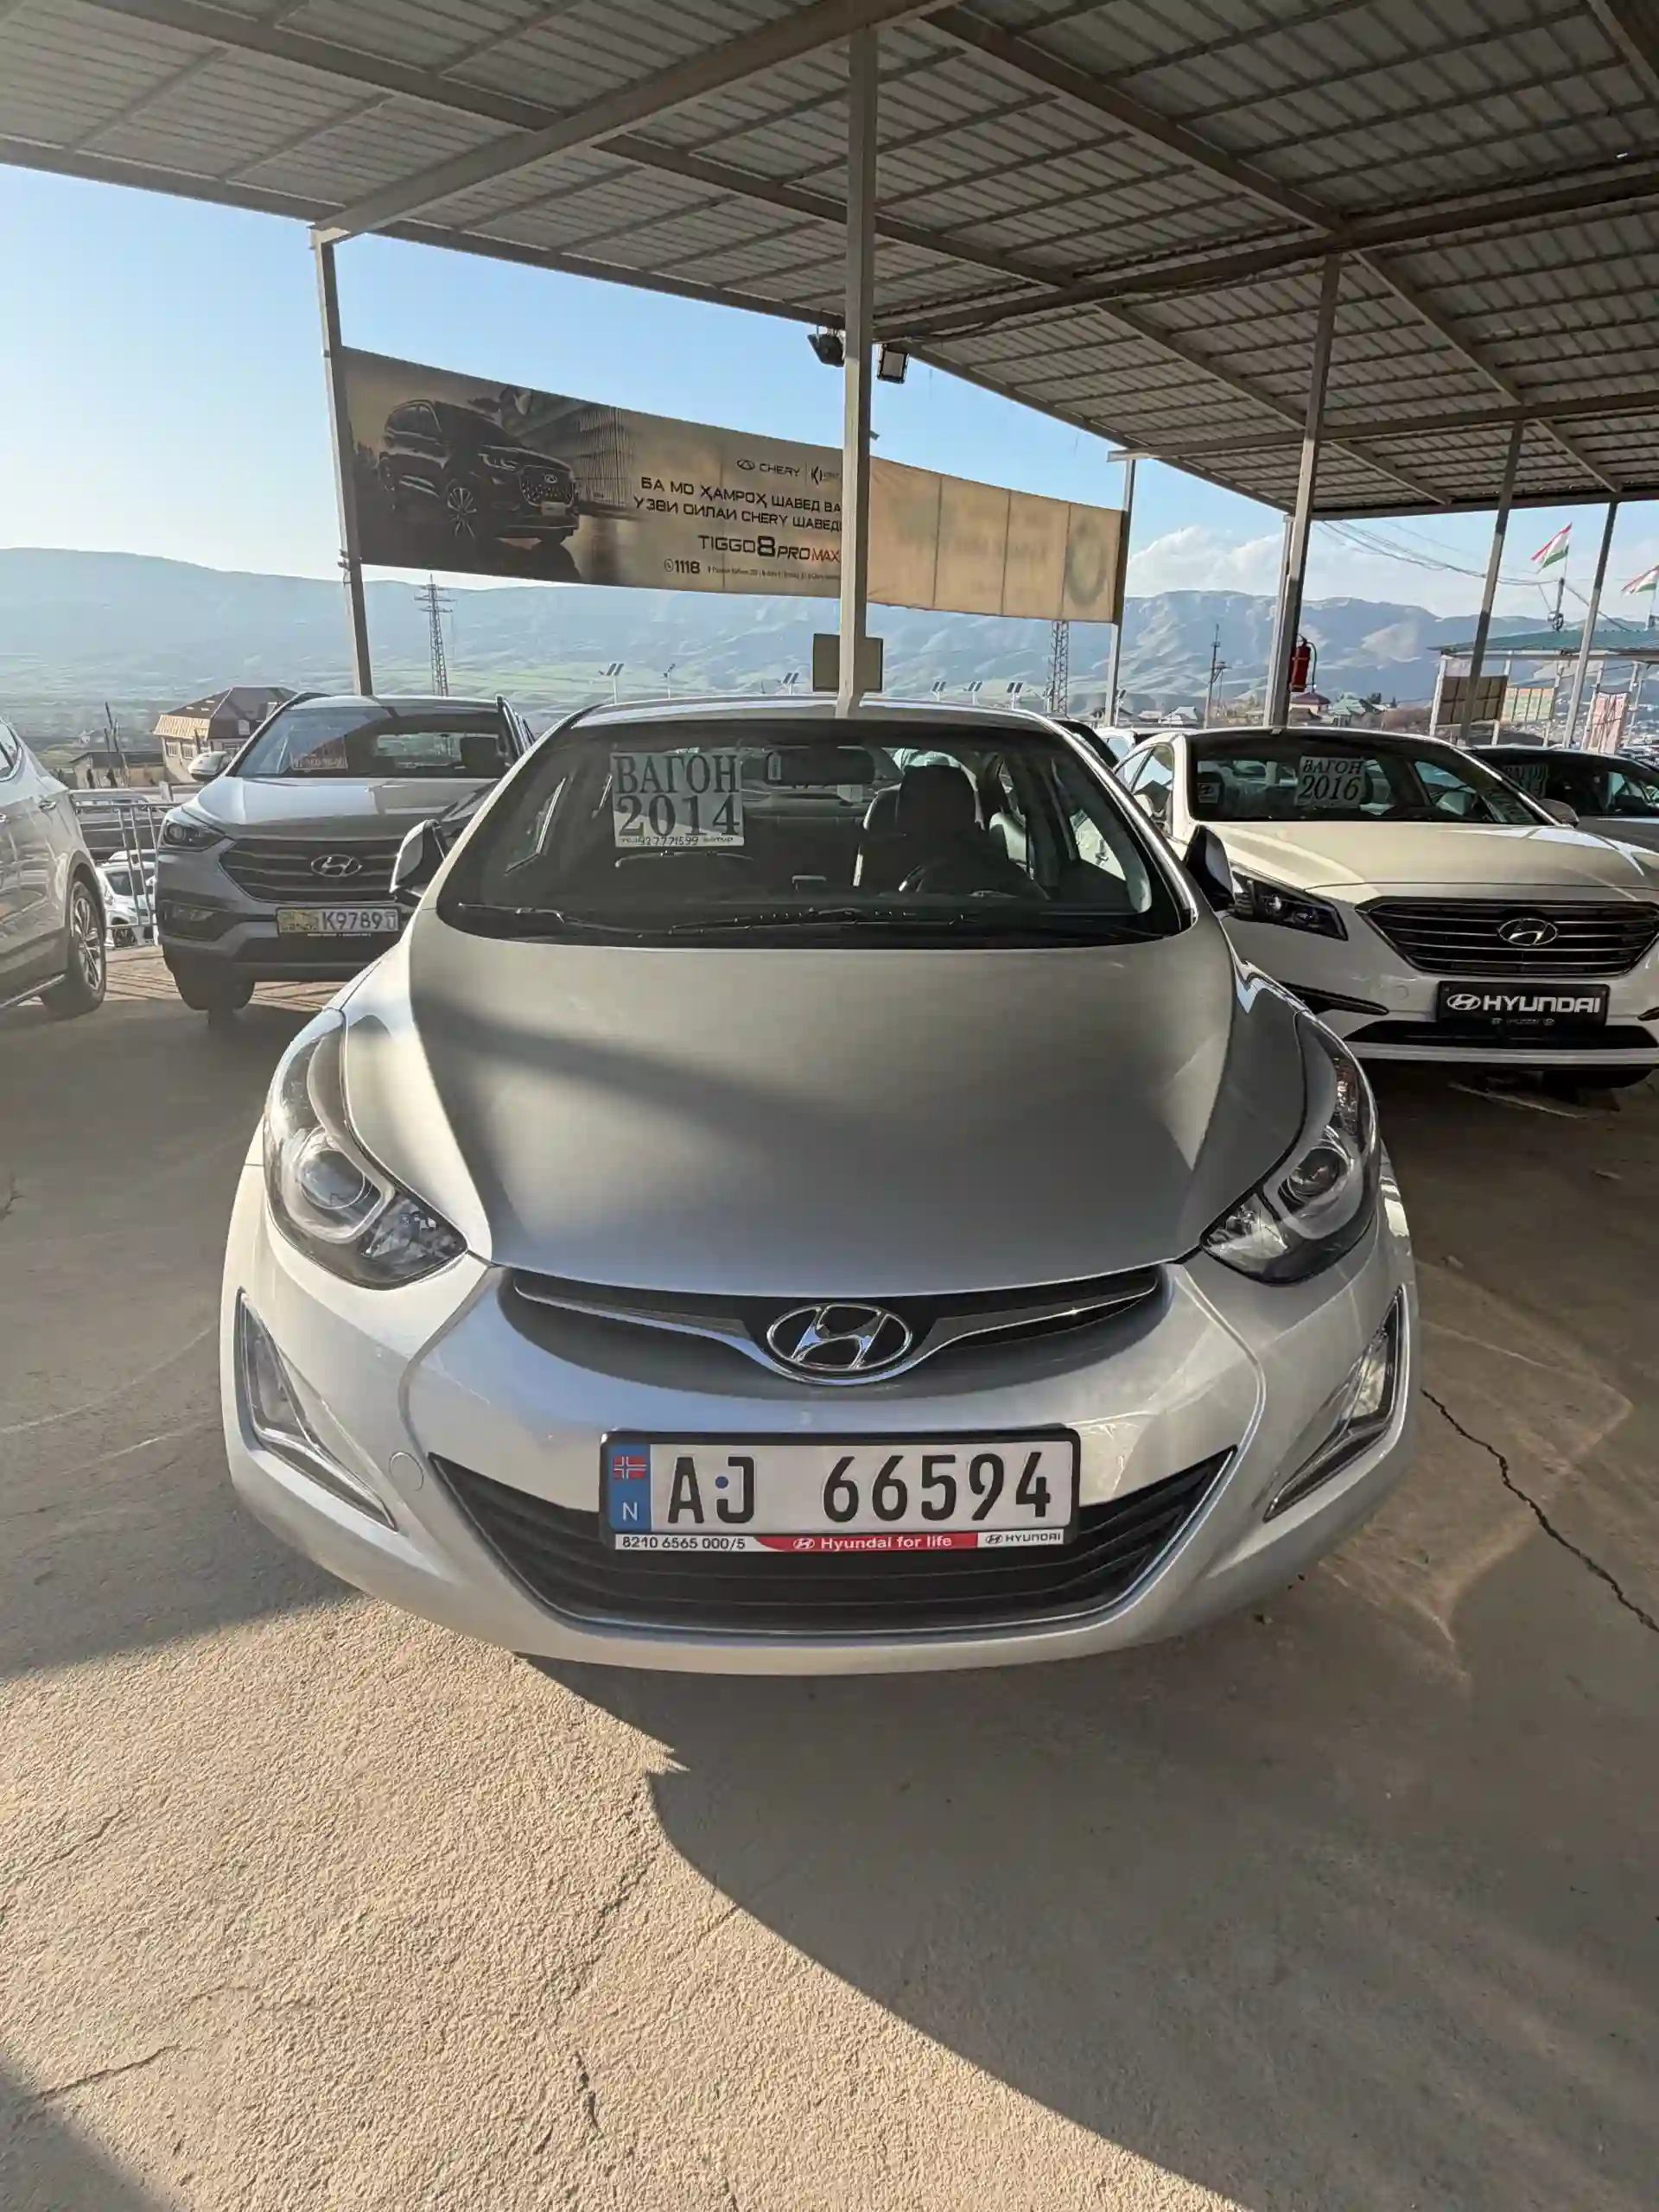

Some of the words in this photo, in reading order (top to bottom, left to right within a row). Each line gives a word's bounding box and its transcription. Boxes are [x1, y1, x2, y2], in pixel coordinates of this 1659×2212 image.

[759, 463, 801, 478] CHERY
[641, 476, 665, 492] БА
[670, 480, 695, 495] МО
[771, 495, 820, 512] ШАВЕД
[823, 500, 841, 512] ВА
[632, 495, 679, 514] УЗВИ
[741, 510, 788, 528] CHERY
[675, 560, 701, 575] 1118
[612, 754, 740, 794] ВАГОН
[1298, 774, 1362, 801] 2016
[616, 794, 741, 836] 2014
[1483, 995, 1601, 1013] HYUNDAI
[822, 1452, 1052, 1523] 66594
[621, 1501, 639, 1521] N
[622, 1536, 658, 1549] 8210
[662, 1537, 698, 1550] 6565
[702, 1537, 746, 1551] 000/5
[820, 1535, 892, 1552] Hyundai
[896, 1536, 921, 1548] for
[926, 1534, 953, 1548] life
[1005, 1533, 1061, 1543] HYUNDAI
